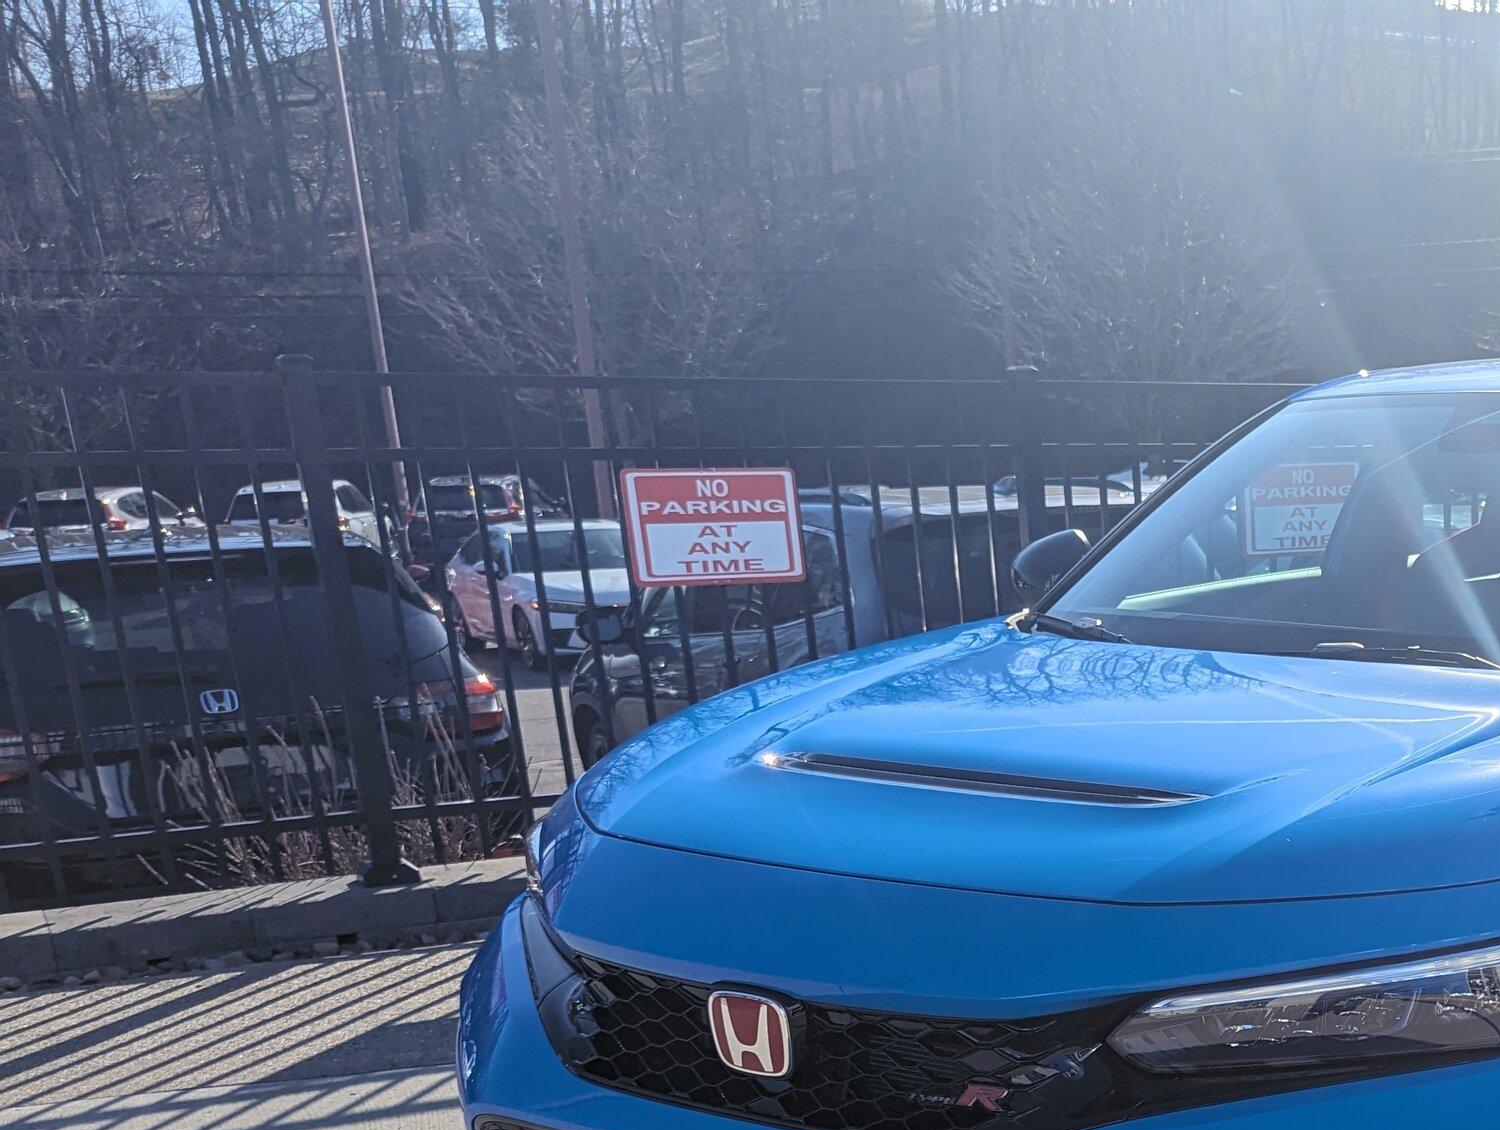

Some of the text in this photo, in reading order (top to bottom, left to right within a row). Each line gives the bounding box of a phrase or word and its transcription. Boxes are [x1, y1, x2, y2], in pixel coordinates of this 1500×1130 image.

[1292, 469, 1315, 484] NO
[695, 479, 729, 498] NO
[1252, 485, 1351, 500] PARKING
[640, 499, 787, 516] PARKING
[1290, 507, 1318, 518] AT
[698, 525, 738, 538] AT
[1282, 520, 1328, 532] ANY
[687, 540, 752, 555] ANY
[1274, 535, 1331, 549] TIME
[677, 558, 765, 574] TIME
